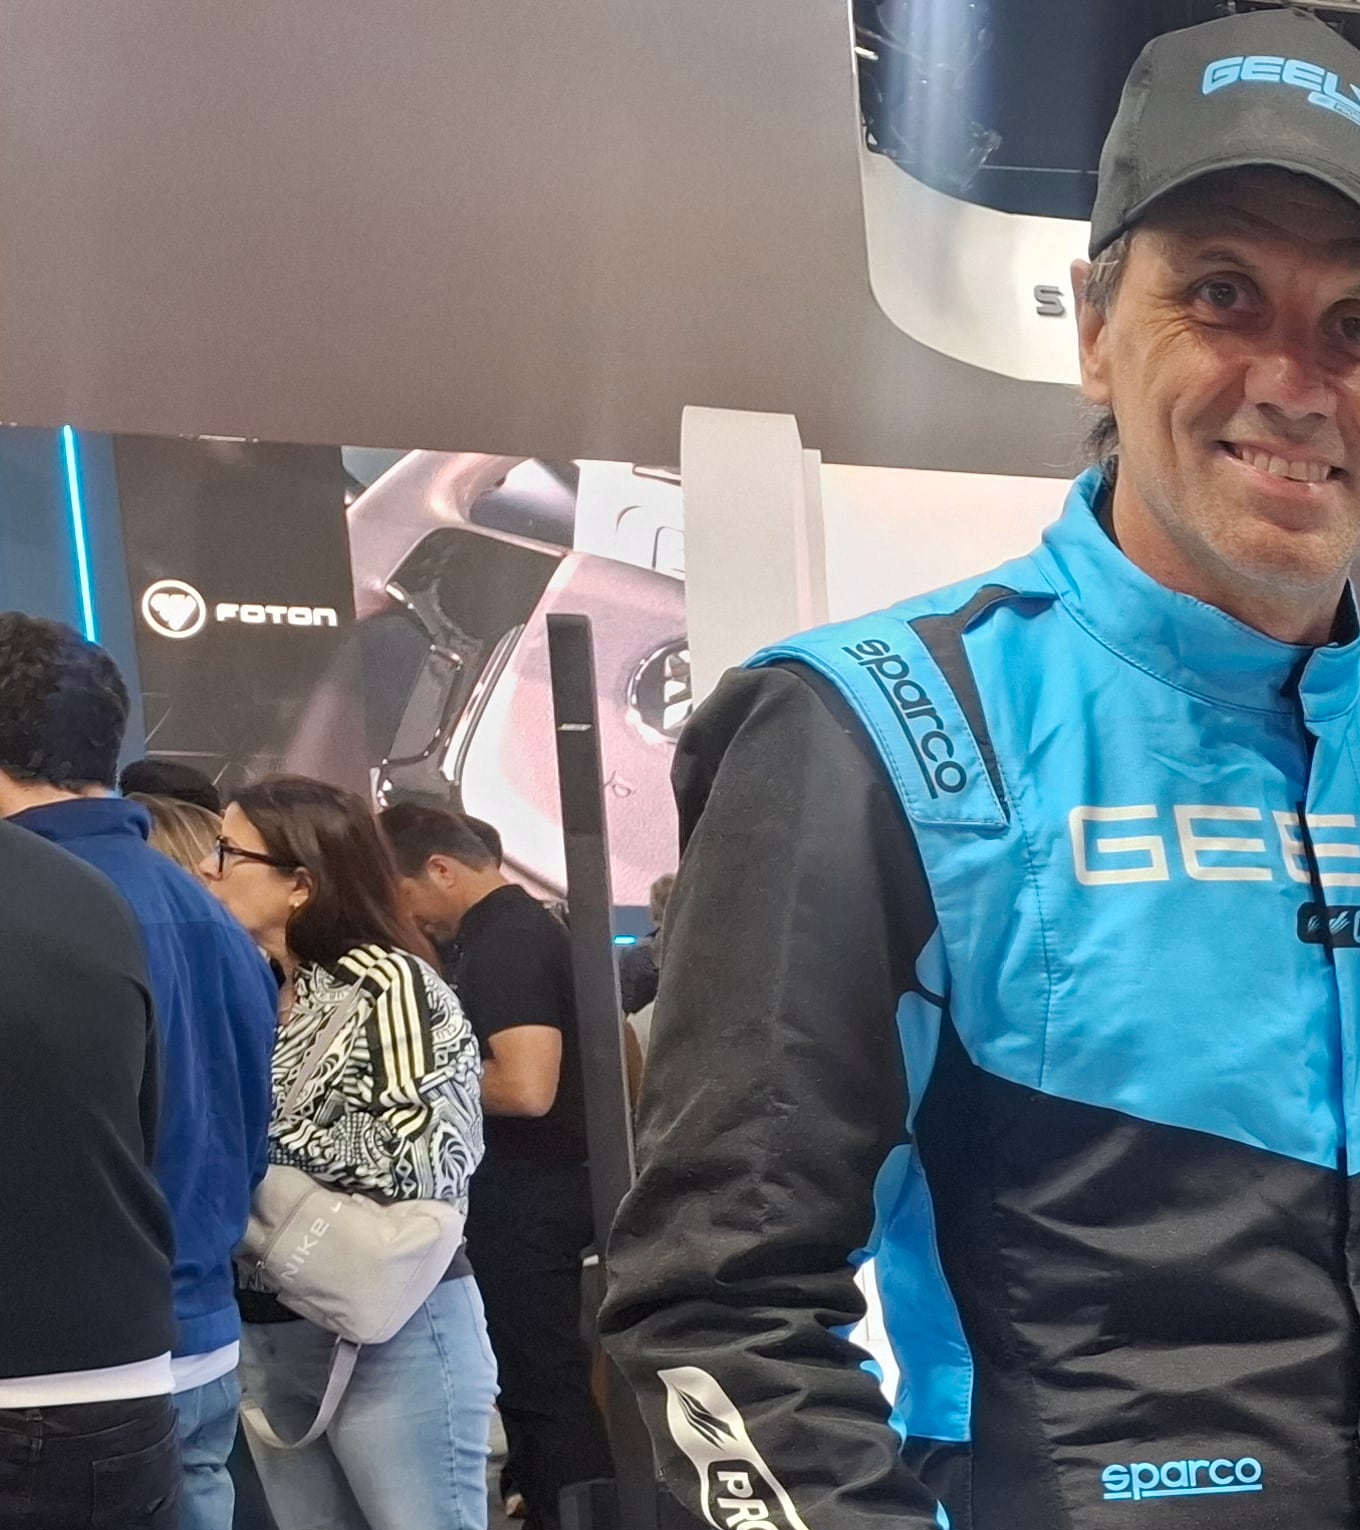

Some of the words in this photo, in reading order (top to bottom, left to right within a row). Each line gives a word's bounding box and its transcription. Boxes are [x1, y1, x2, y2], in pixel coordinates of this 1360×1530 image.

[216, 603, 338, 627] FOTON
[855, 639, 967, 794] sparco
[281, 1217, 330, 1281] NIKE
[1102, 1457, 1262, 1499] sparco
